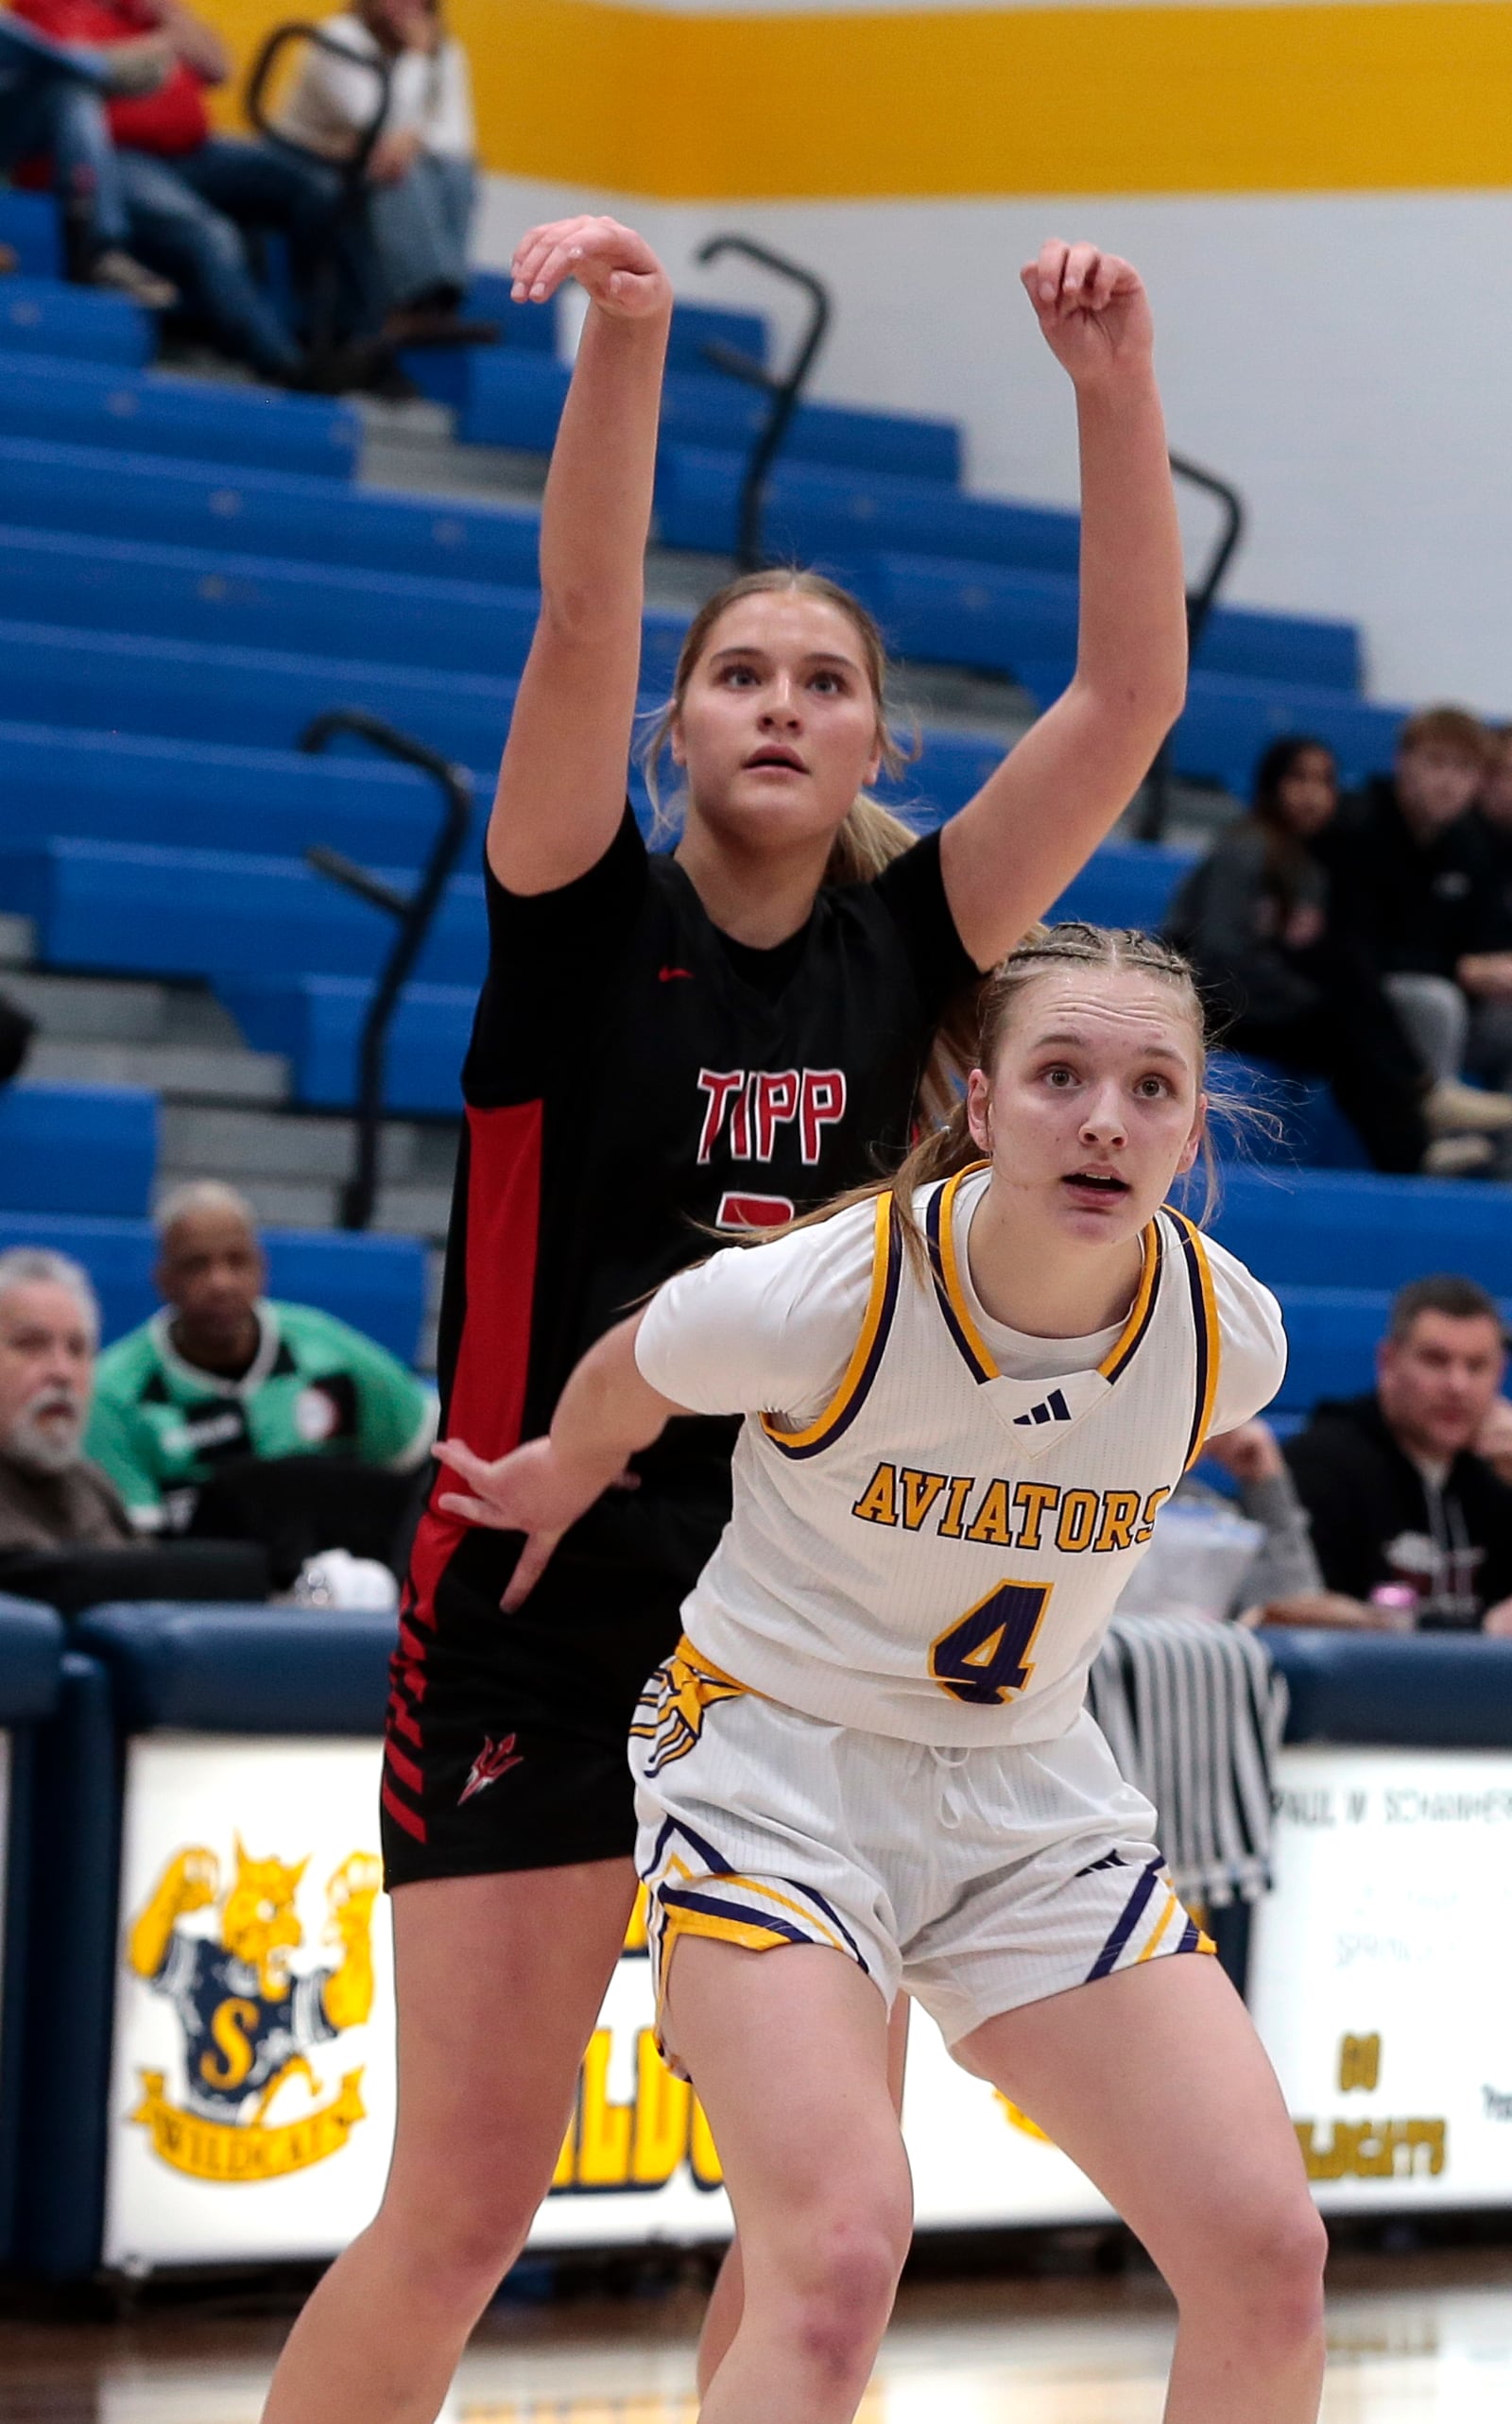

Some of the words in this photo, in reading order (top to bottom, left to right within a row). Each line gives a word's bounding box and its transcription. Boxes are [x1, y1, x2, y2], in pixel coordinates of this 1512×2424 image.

[696, 1067, 847, 1165] TIPP
[851, 1461, 1171, 1553] AVIATORS
[927, 1577, 1055, 1704] 4
[199, 1997, 261, 2090] S
